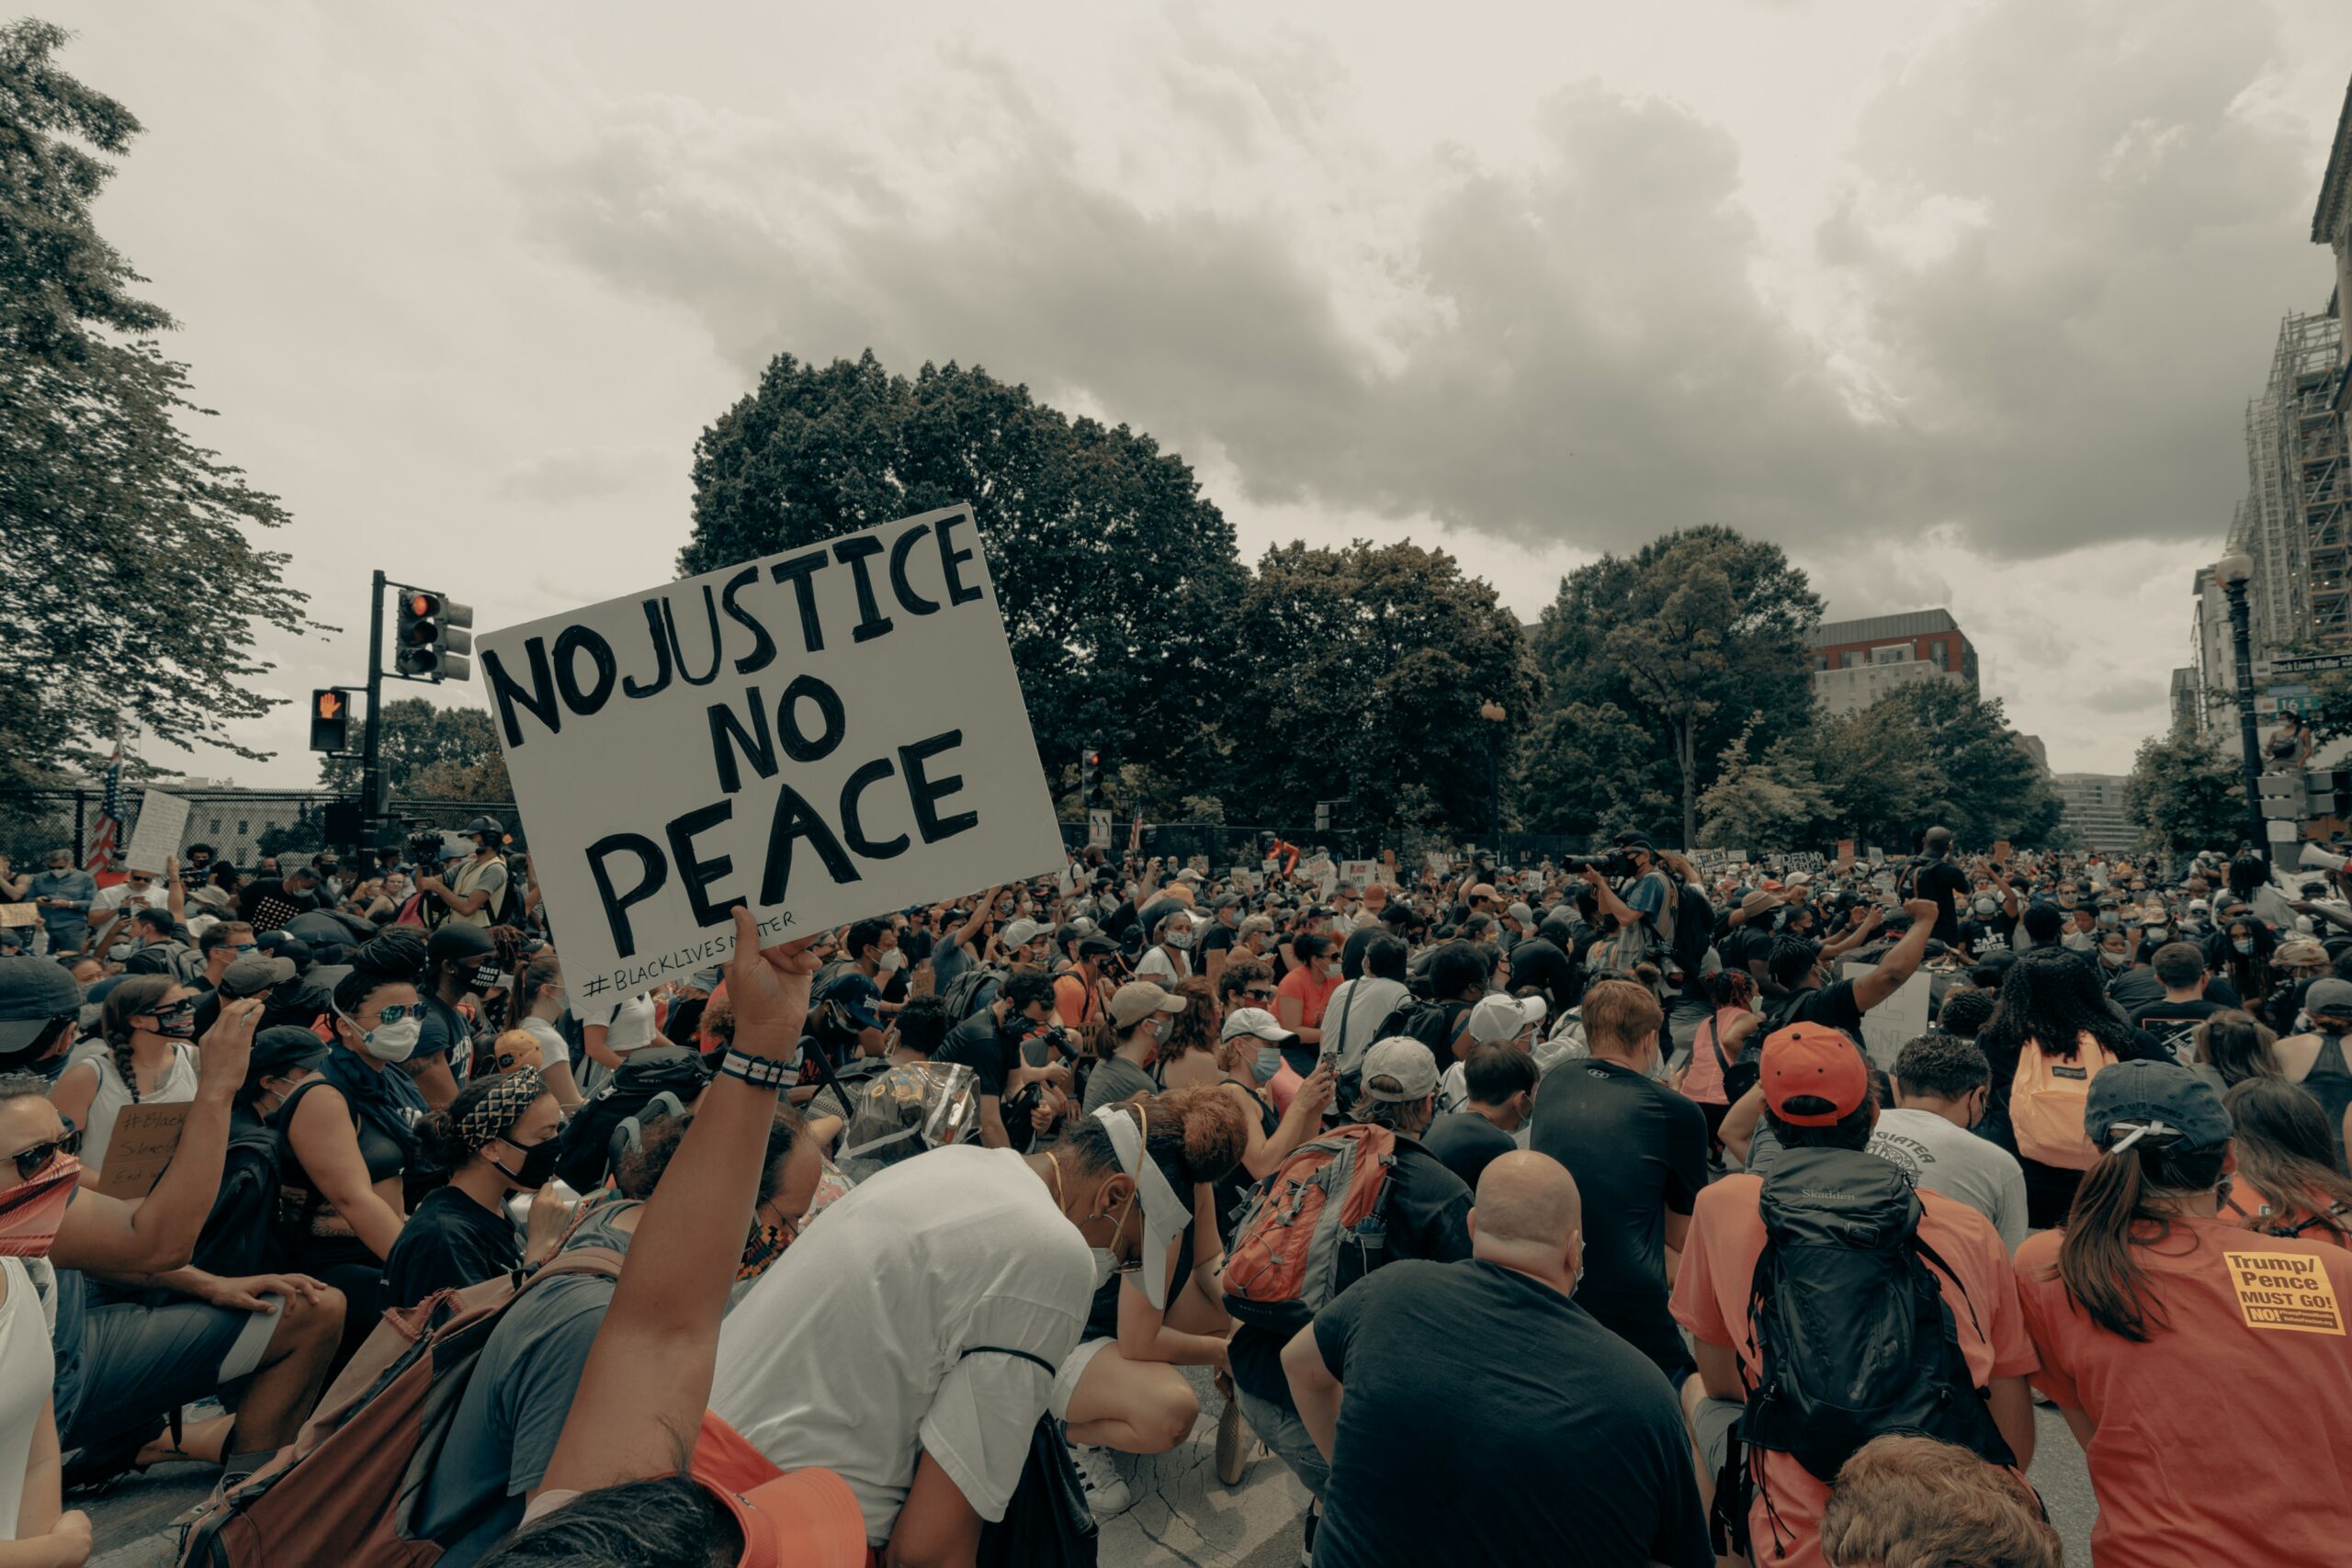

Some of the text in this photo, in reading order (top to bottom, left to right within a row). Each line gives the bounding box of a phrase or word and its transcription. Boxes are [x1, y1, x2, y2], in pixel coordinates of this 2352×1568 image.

[481, 514, 984, 749] NO JUSTICE
[2293, 661, 2313, 671] Lives
[2314, 659, 2339, 670] Matter
[2281, 698, 2299, 710] 16
[707, 673, 845, 794] NO
[585, 728, 978, 958] PEACE
[477, 973, 495, 982] LIVES
[479, 965, 499, 976] BLACK
[469, 978, 494, 987] MATTER
[1801, 1189, 1857, 1201] Skadden
[2228, 1255, 2314, 1275] Trump/
[2241, 1271, 2319, 1291] Pence
[2240, 1291, 2334, 1309] MUST GO!
[2249, 1307, 2282, 1323] NO!
